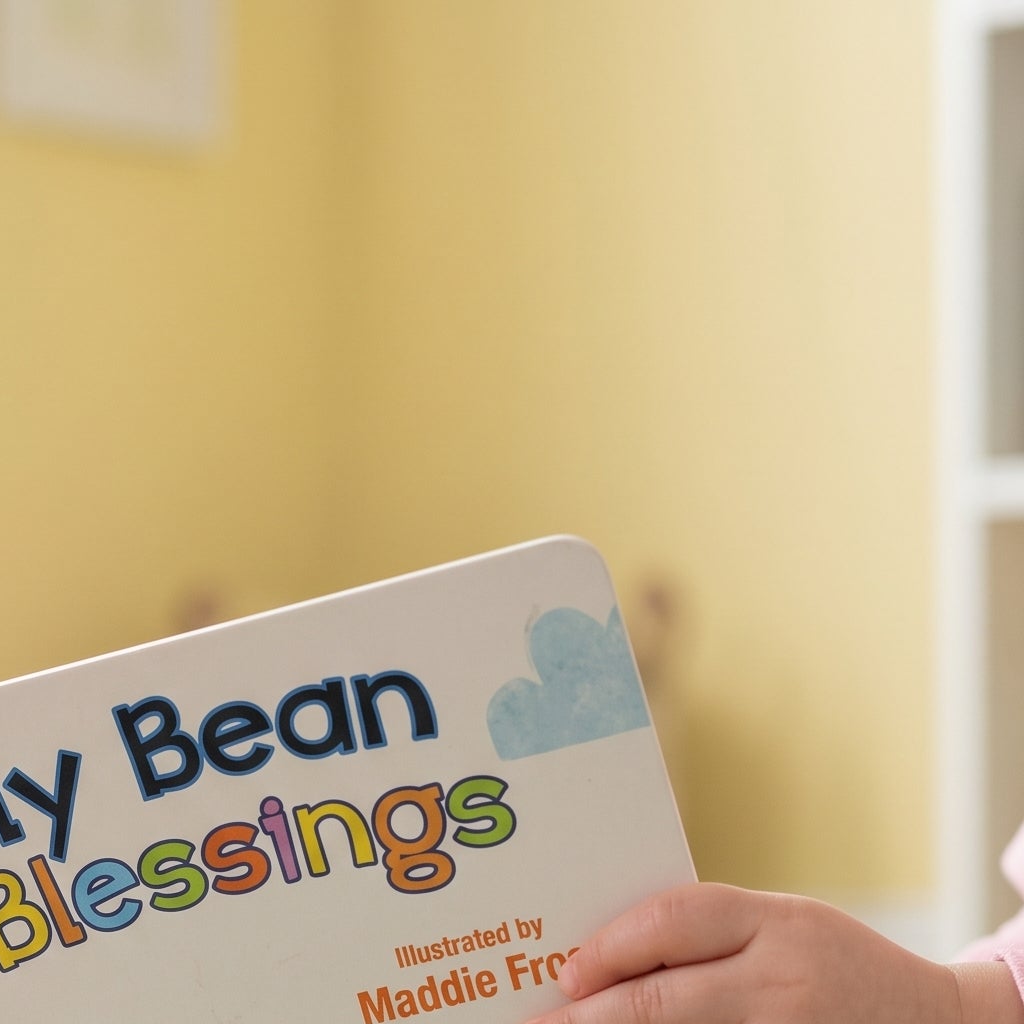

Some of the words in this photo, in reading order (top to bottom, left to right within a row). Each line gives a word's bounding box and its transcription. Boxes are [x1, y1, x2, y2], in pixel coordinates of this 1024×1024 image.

[112, 670, 438, 802] Bean
[394, 921, 511, 969] Illustrated
[514, 917, 543, 941] by
[505, 946, 581, 992] Fro
